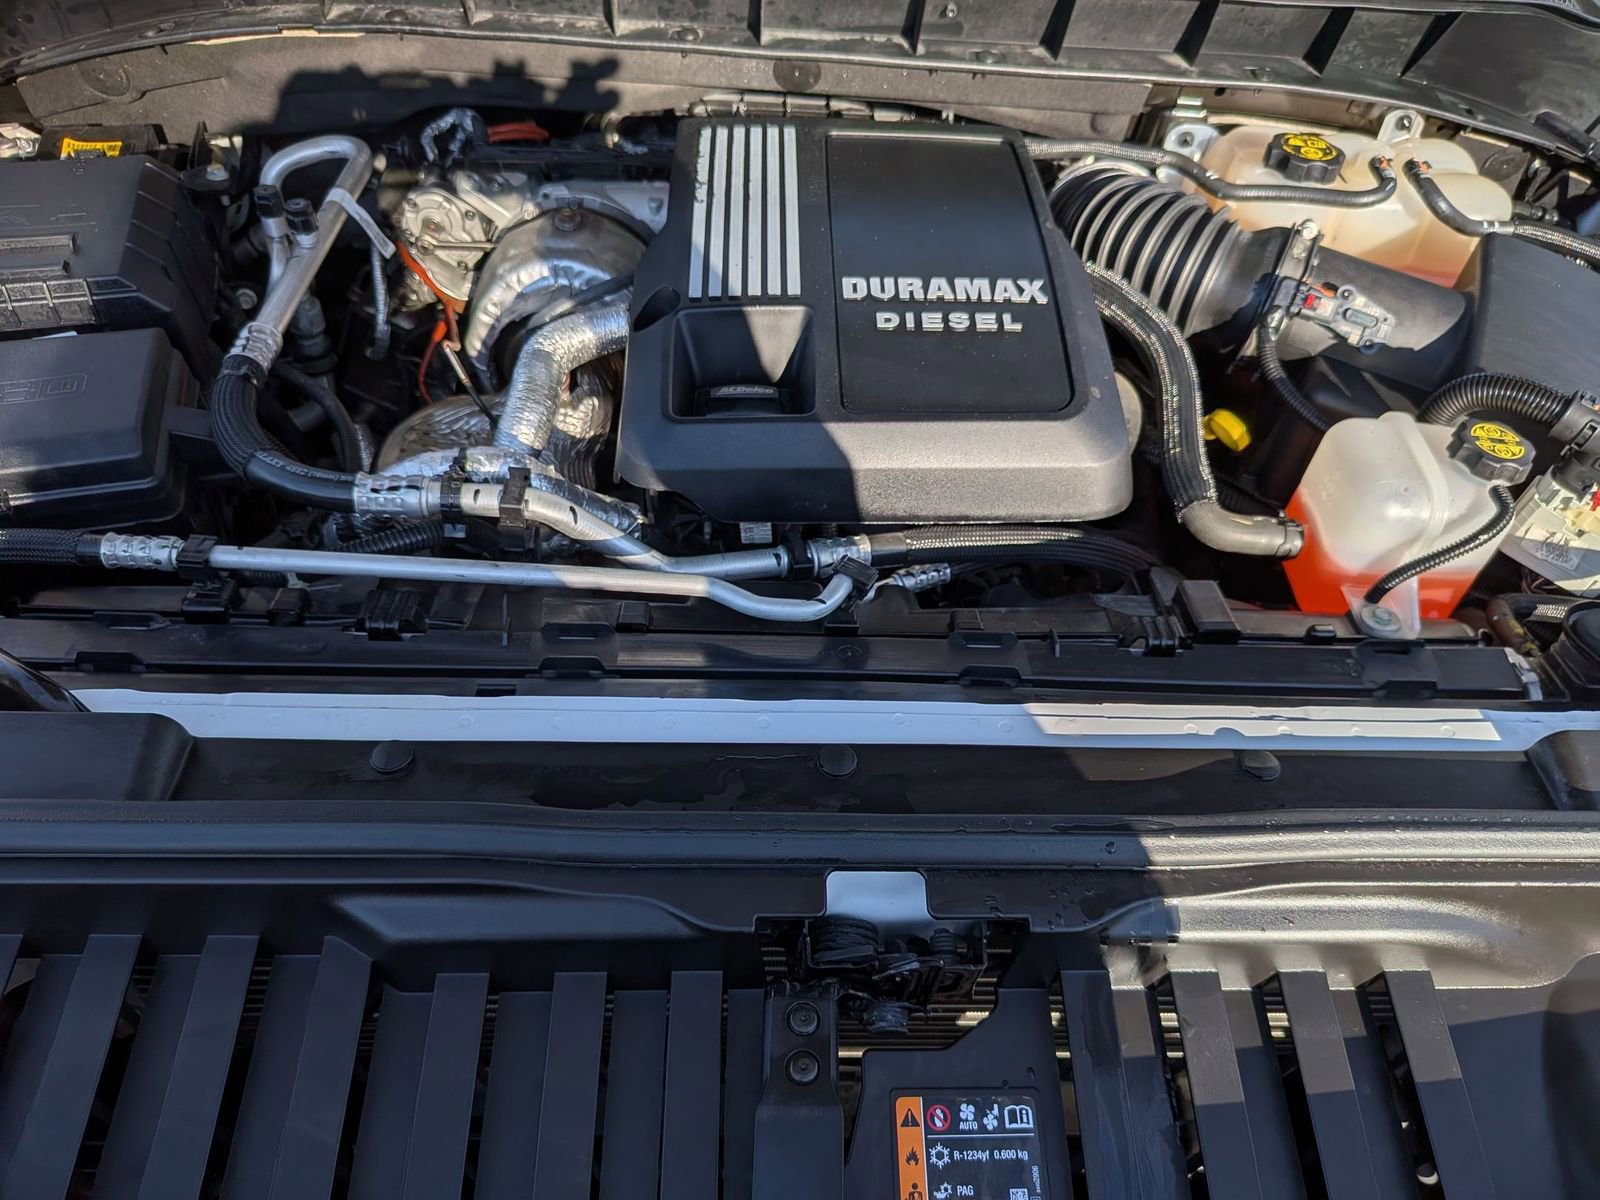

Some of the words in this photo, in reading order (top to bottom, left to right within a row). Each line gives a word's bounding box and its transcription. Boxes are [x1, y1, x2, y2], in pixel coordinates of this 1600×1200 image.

[841, 276, 1049, 305] DURAMAX
[875, 311, 1023, 333] DIESEL
[717, 386, 774, 396] ACDelco
[959, 1121, 978, 1130] AUTO
[953, 1149, 990, 1162] R-1234yf
[993, 1149, 1017, 1160] 0.600
[1017, 1149, 1029, 1161] kg
[957, 1185, 974, 1197] PAG
